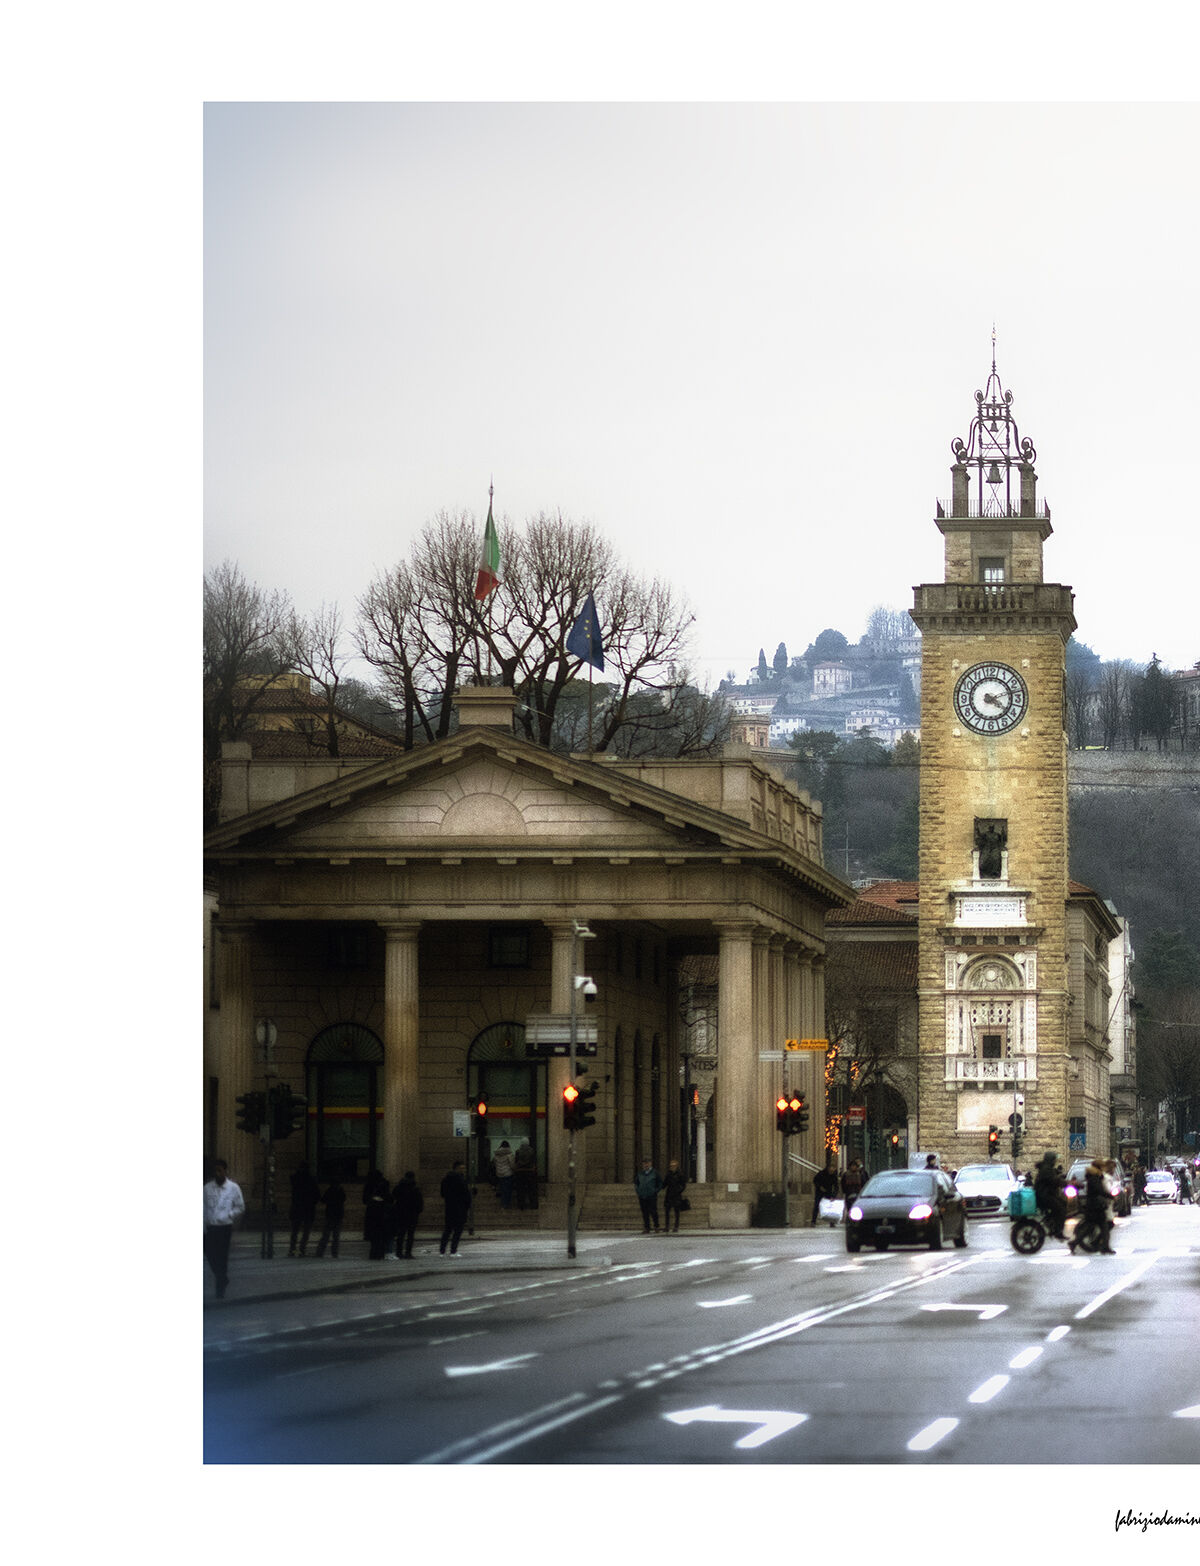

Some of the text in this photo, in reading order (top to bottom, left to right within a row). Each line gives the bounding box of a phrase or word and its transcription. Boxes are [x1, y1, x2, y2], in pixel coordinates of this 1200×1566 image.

[974, 670, 981, 680] 11
[986, 667, 996, 677] 12
[962, 680, 973, 690] 10
[1011, 680, 1018, 690] 2
[960, 694, 967, 704] 9
[1014, 694, 1022, 704] 3
[964, 707, 971, 717] 8
[1010, 709, 1017, 718] 4
[974, 718, 981, 728] 7
[987, 721, 995, 731] 6
[1001, 717, 1009, 727] 5
